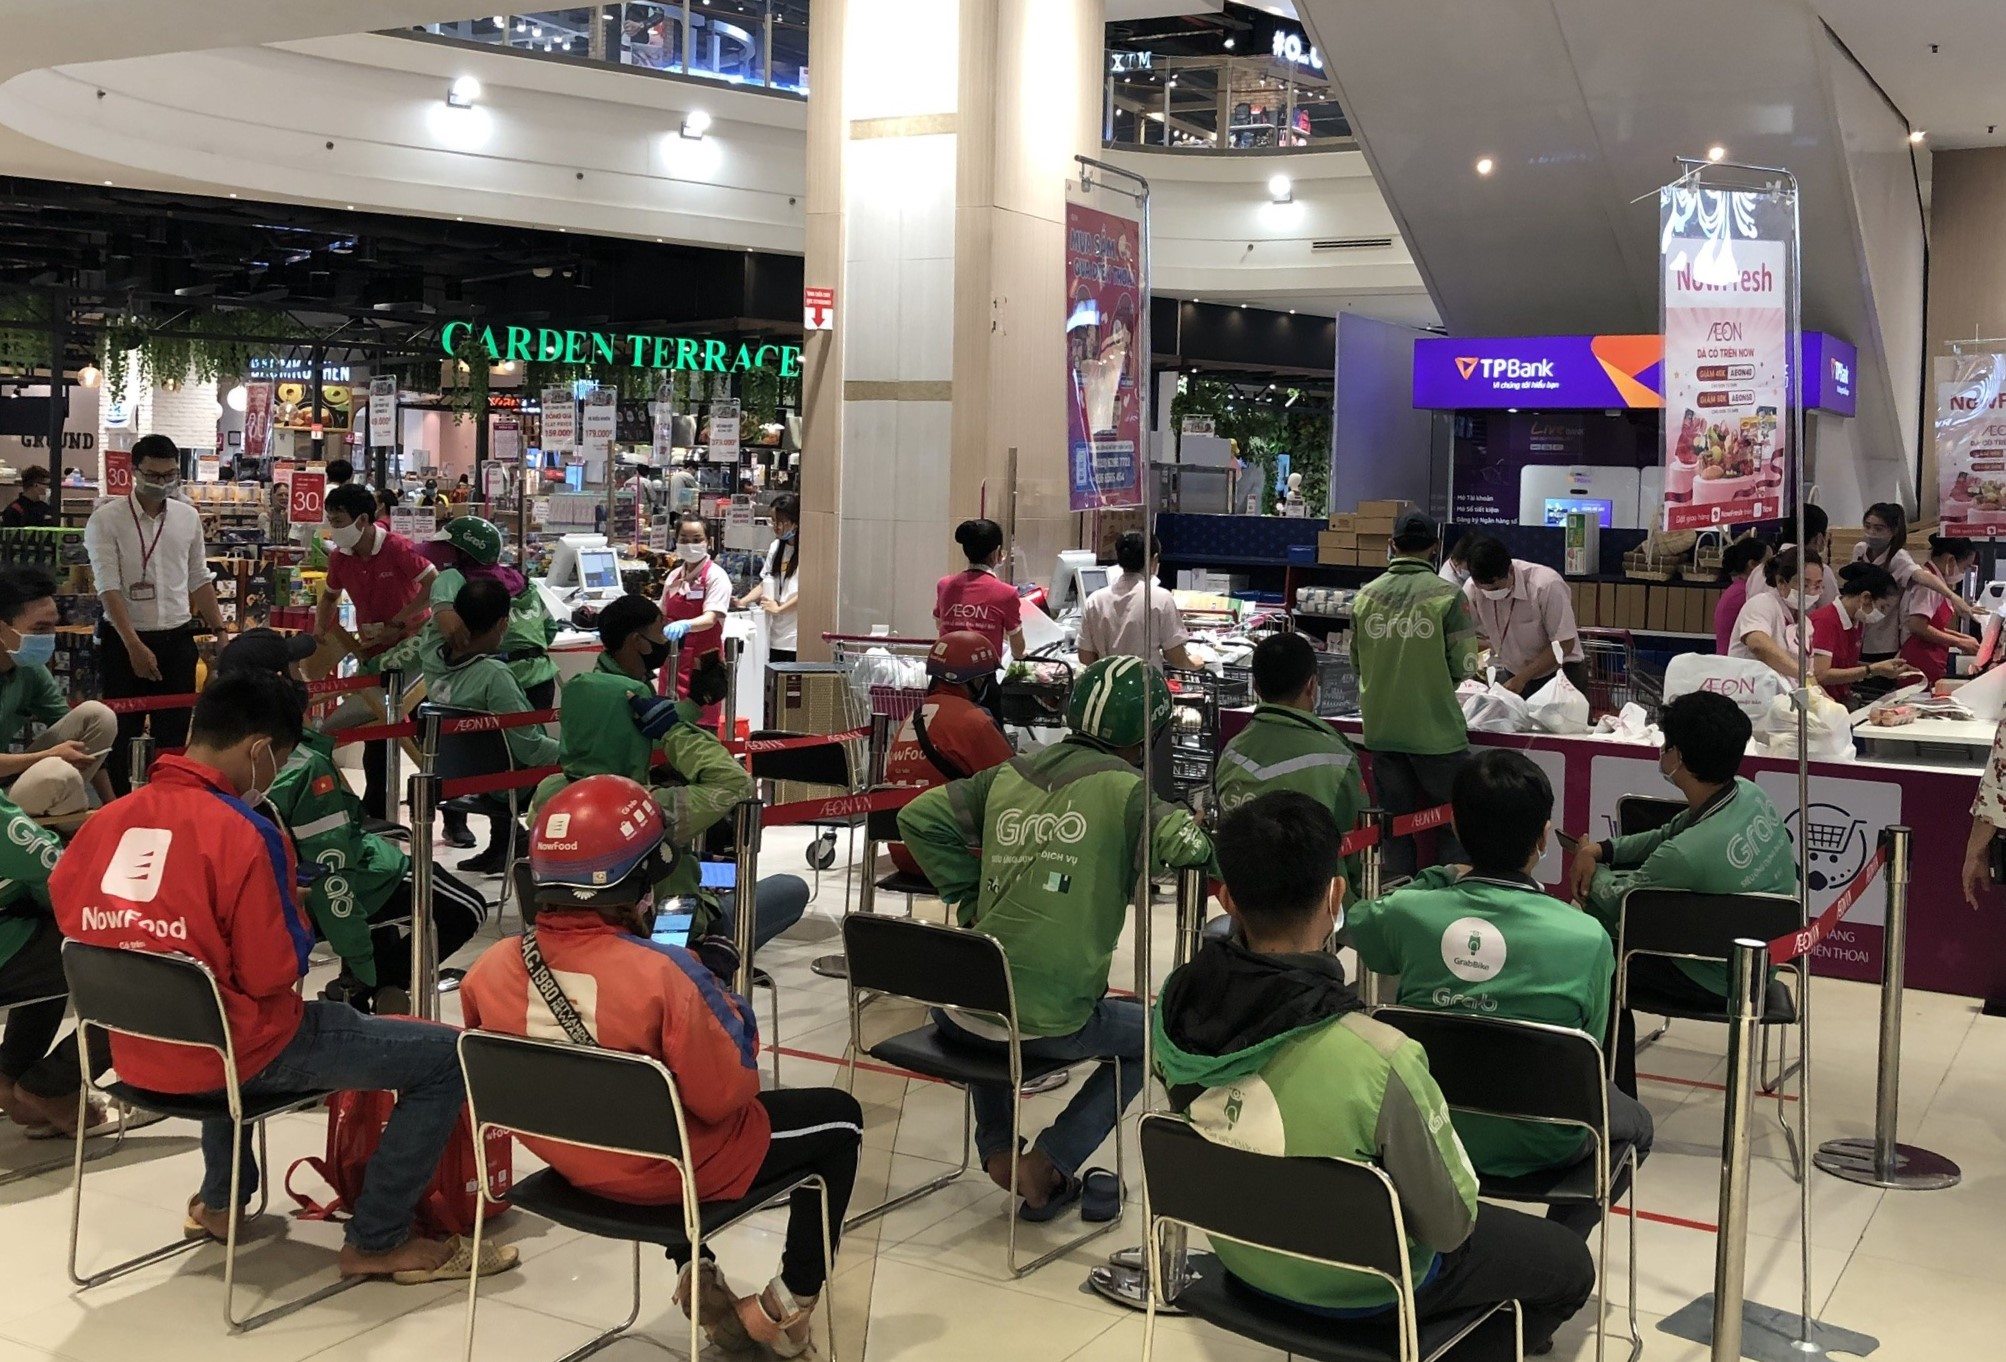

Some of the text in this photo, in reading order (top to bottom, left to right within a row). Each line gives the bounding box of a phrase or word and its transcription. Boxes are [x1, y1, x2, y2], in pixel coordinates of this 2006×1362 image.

[441, 321, 800, 379] GARDEN TERRACE
[1739, 348, 1755, 357] NOW
[1480, 358, 1554, 378] TPBank
[21, 432, 94, 449] GRUND
[463, 530, 486, 549] Grab
[1365, 610, 1435, 639] Grab
[1151, 698, 1171, 720] rab
[996, 800, 1087, 846] Grab
[1727, 797, 1780, 869] Grab
[7, 816, 66, 871] Gra
[537, 841, 578, 851] NowFood
[1041, 850, 1064, 862] DỊCH
[1066, 855, 1078, 866] VỤ
[82, 906, 186, 940] NowFood
[1454, 957, 1490, 970] GrabBike
[1433, 987, 1498, 1012] Grab
